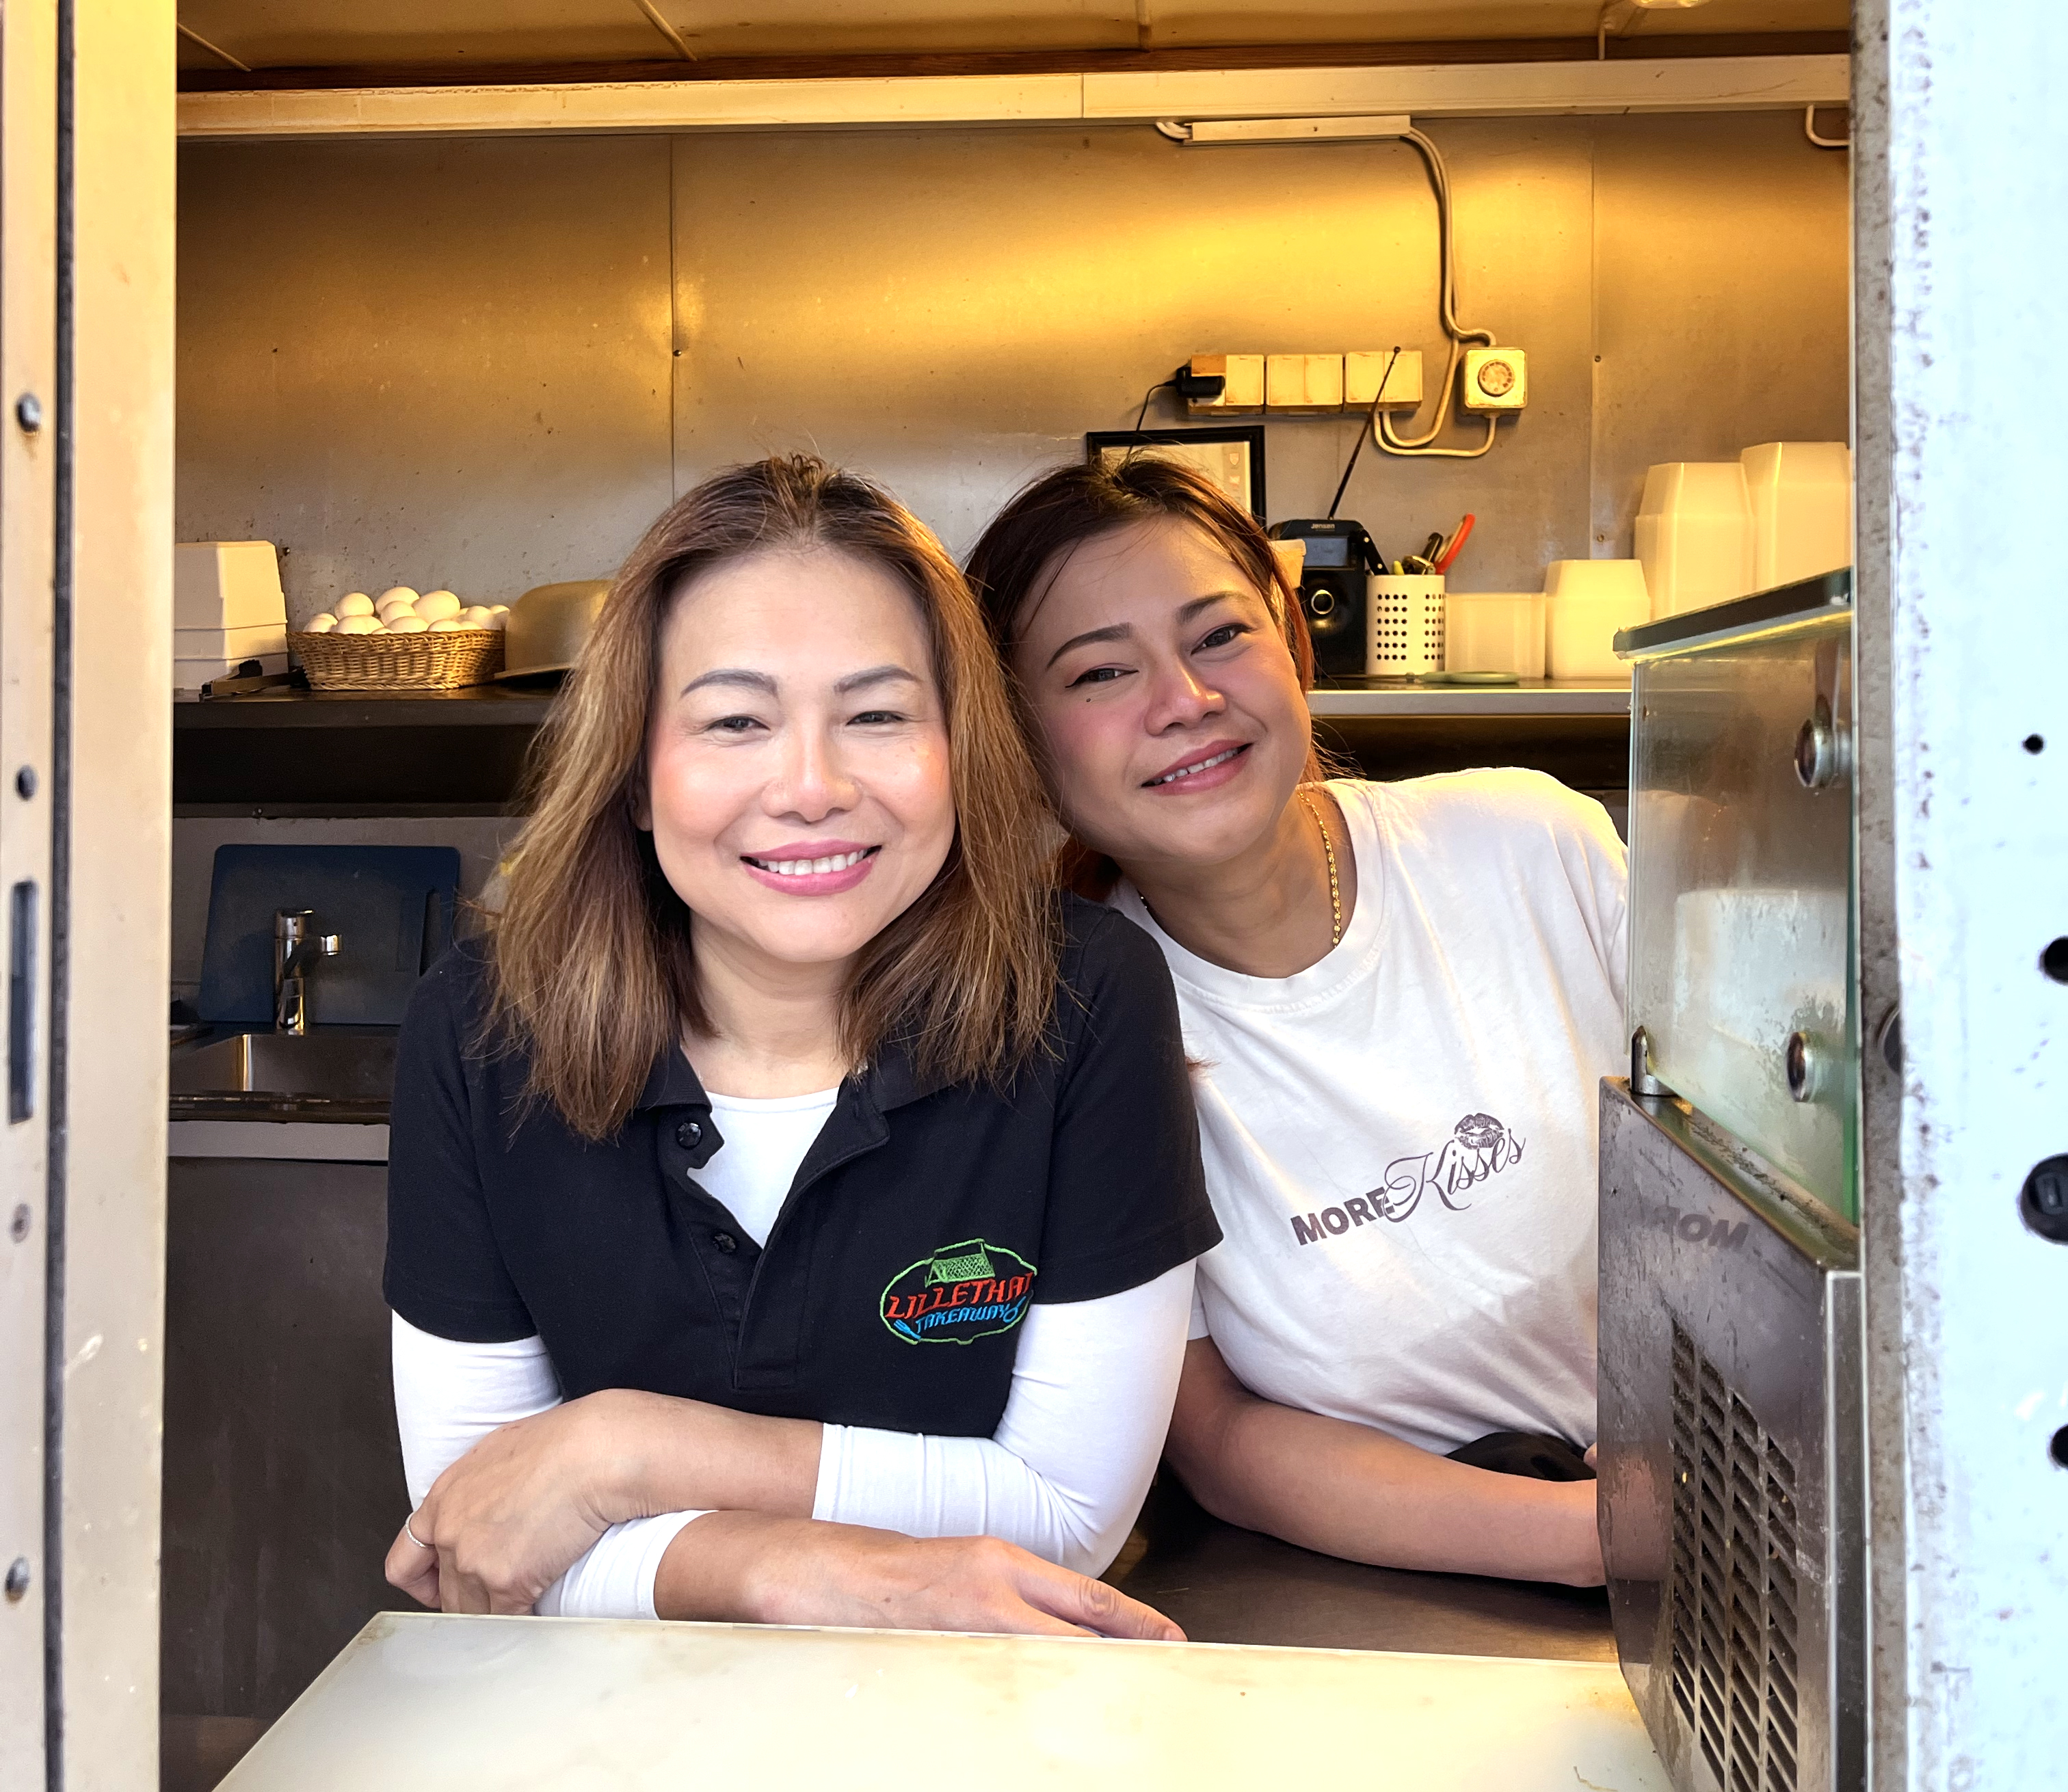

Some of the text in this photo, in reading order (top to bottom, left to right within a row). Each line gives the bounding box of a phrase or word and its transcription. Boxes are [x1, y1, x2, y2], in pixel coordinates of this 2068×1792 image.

[1290, 1128, 1526, 1246] MORE Kisses
[915, 1303, 1011, 1334] TAKEAWAY
